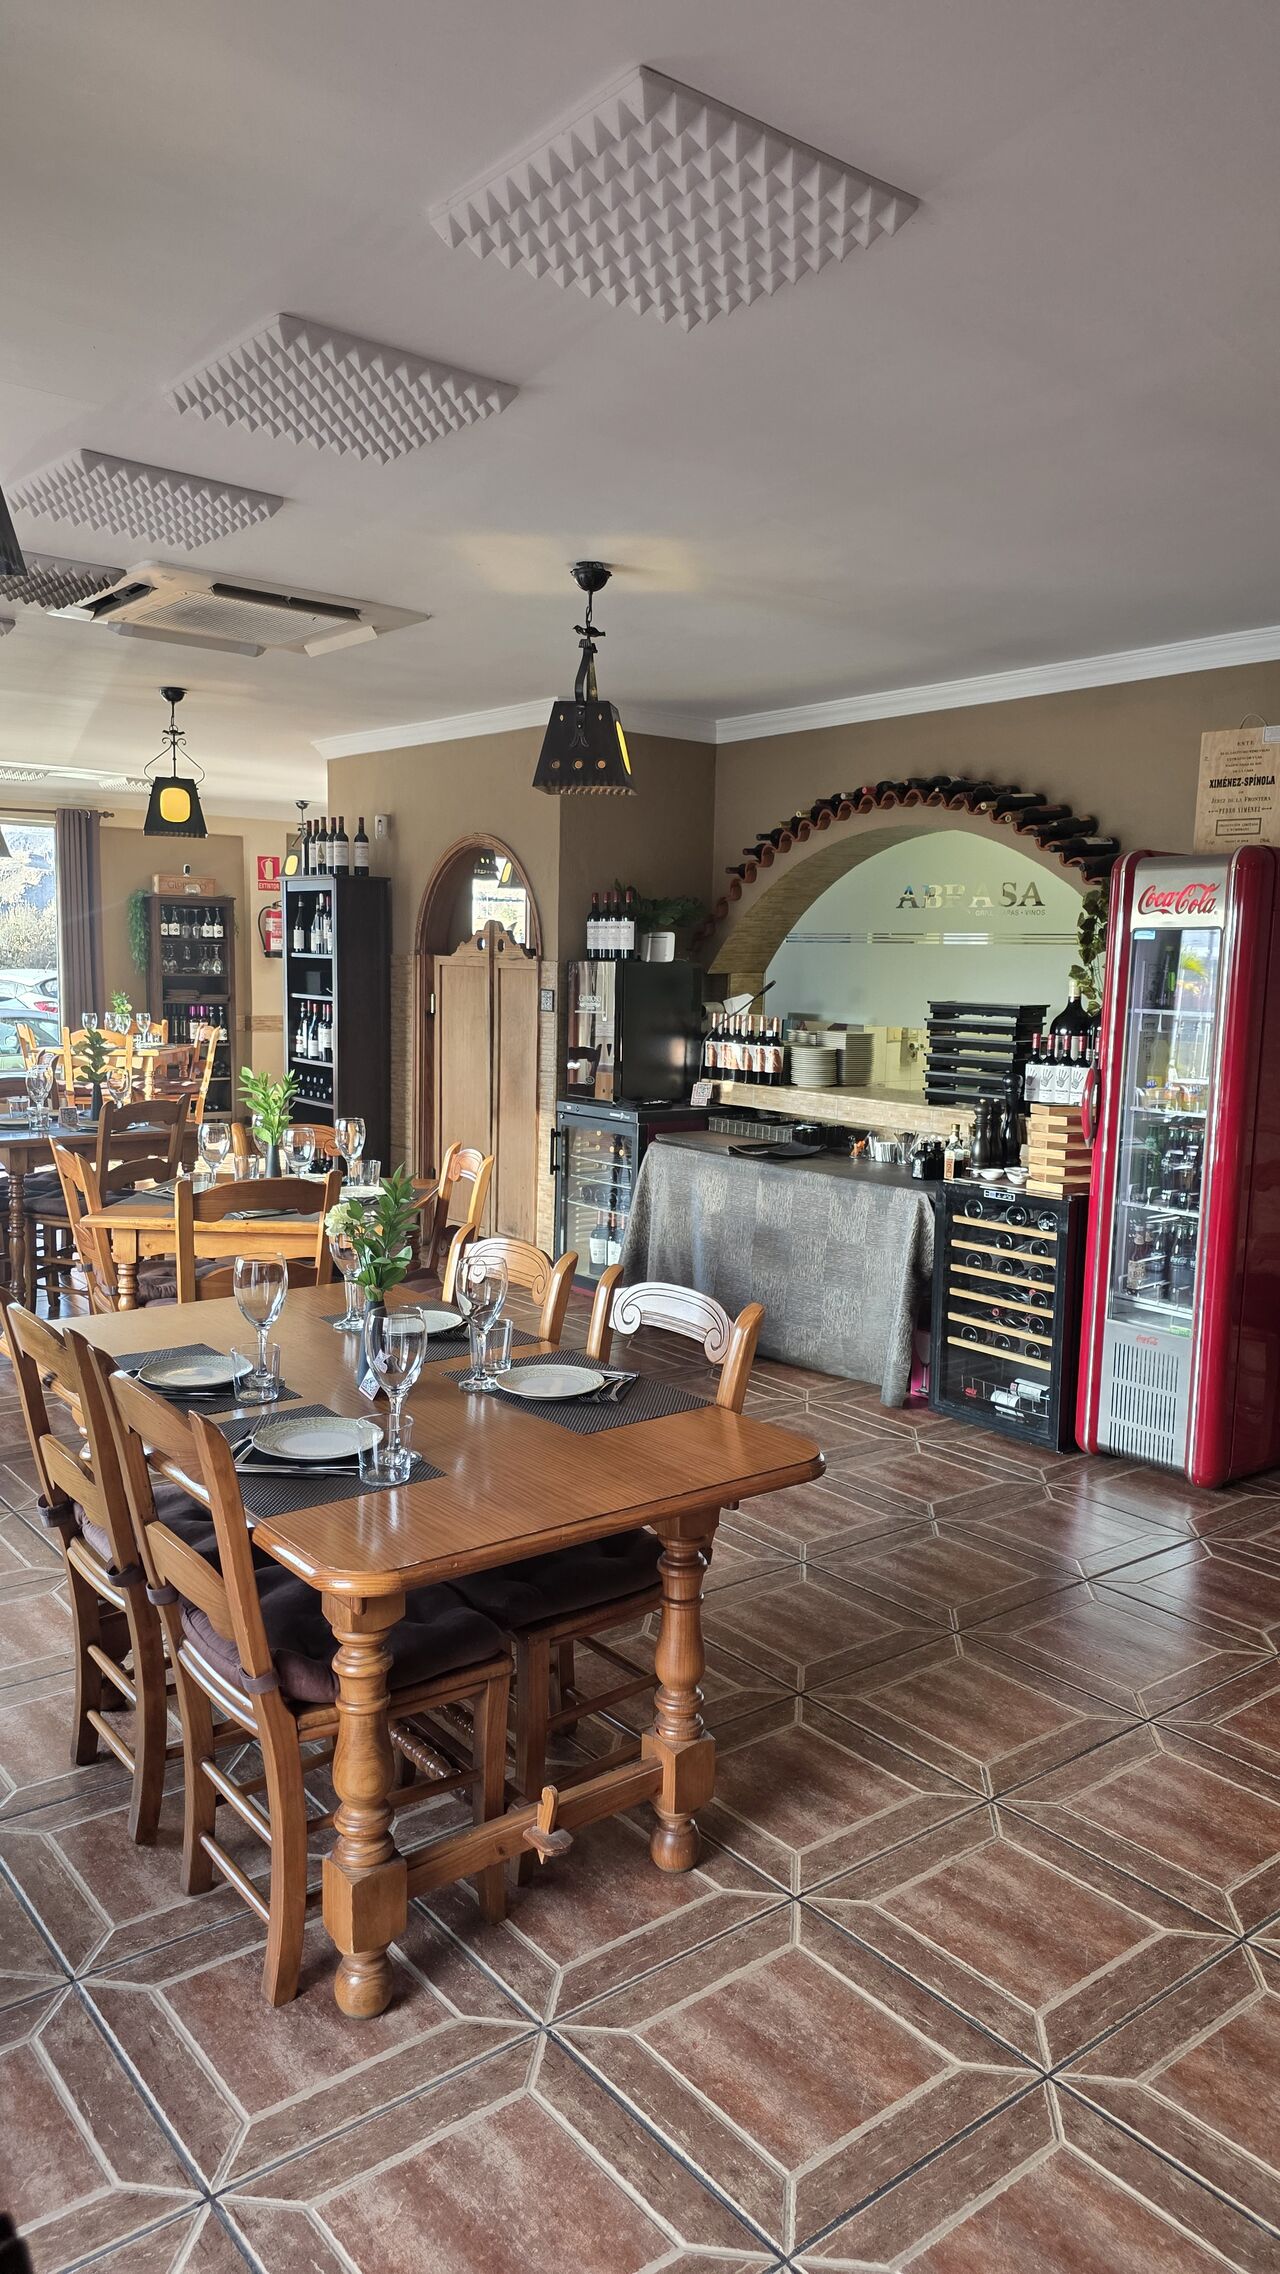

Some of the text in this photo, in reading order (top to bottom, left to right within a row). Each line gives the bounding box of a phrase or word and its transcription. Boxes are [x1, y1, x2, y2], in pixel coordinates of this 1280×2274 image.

[1209, 774, 1275, 788] XIMÉNEZ-SPÍNOLA
[258, 882, 280, 890] EXTINTOR
[1137, 883, 1221, 915] Coca-Cola
[1025, 909, 1046, 917] VINOS
